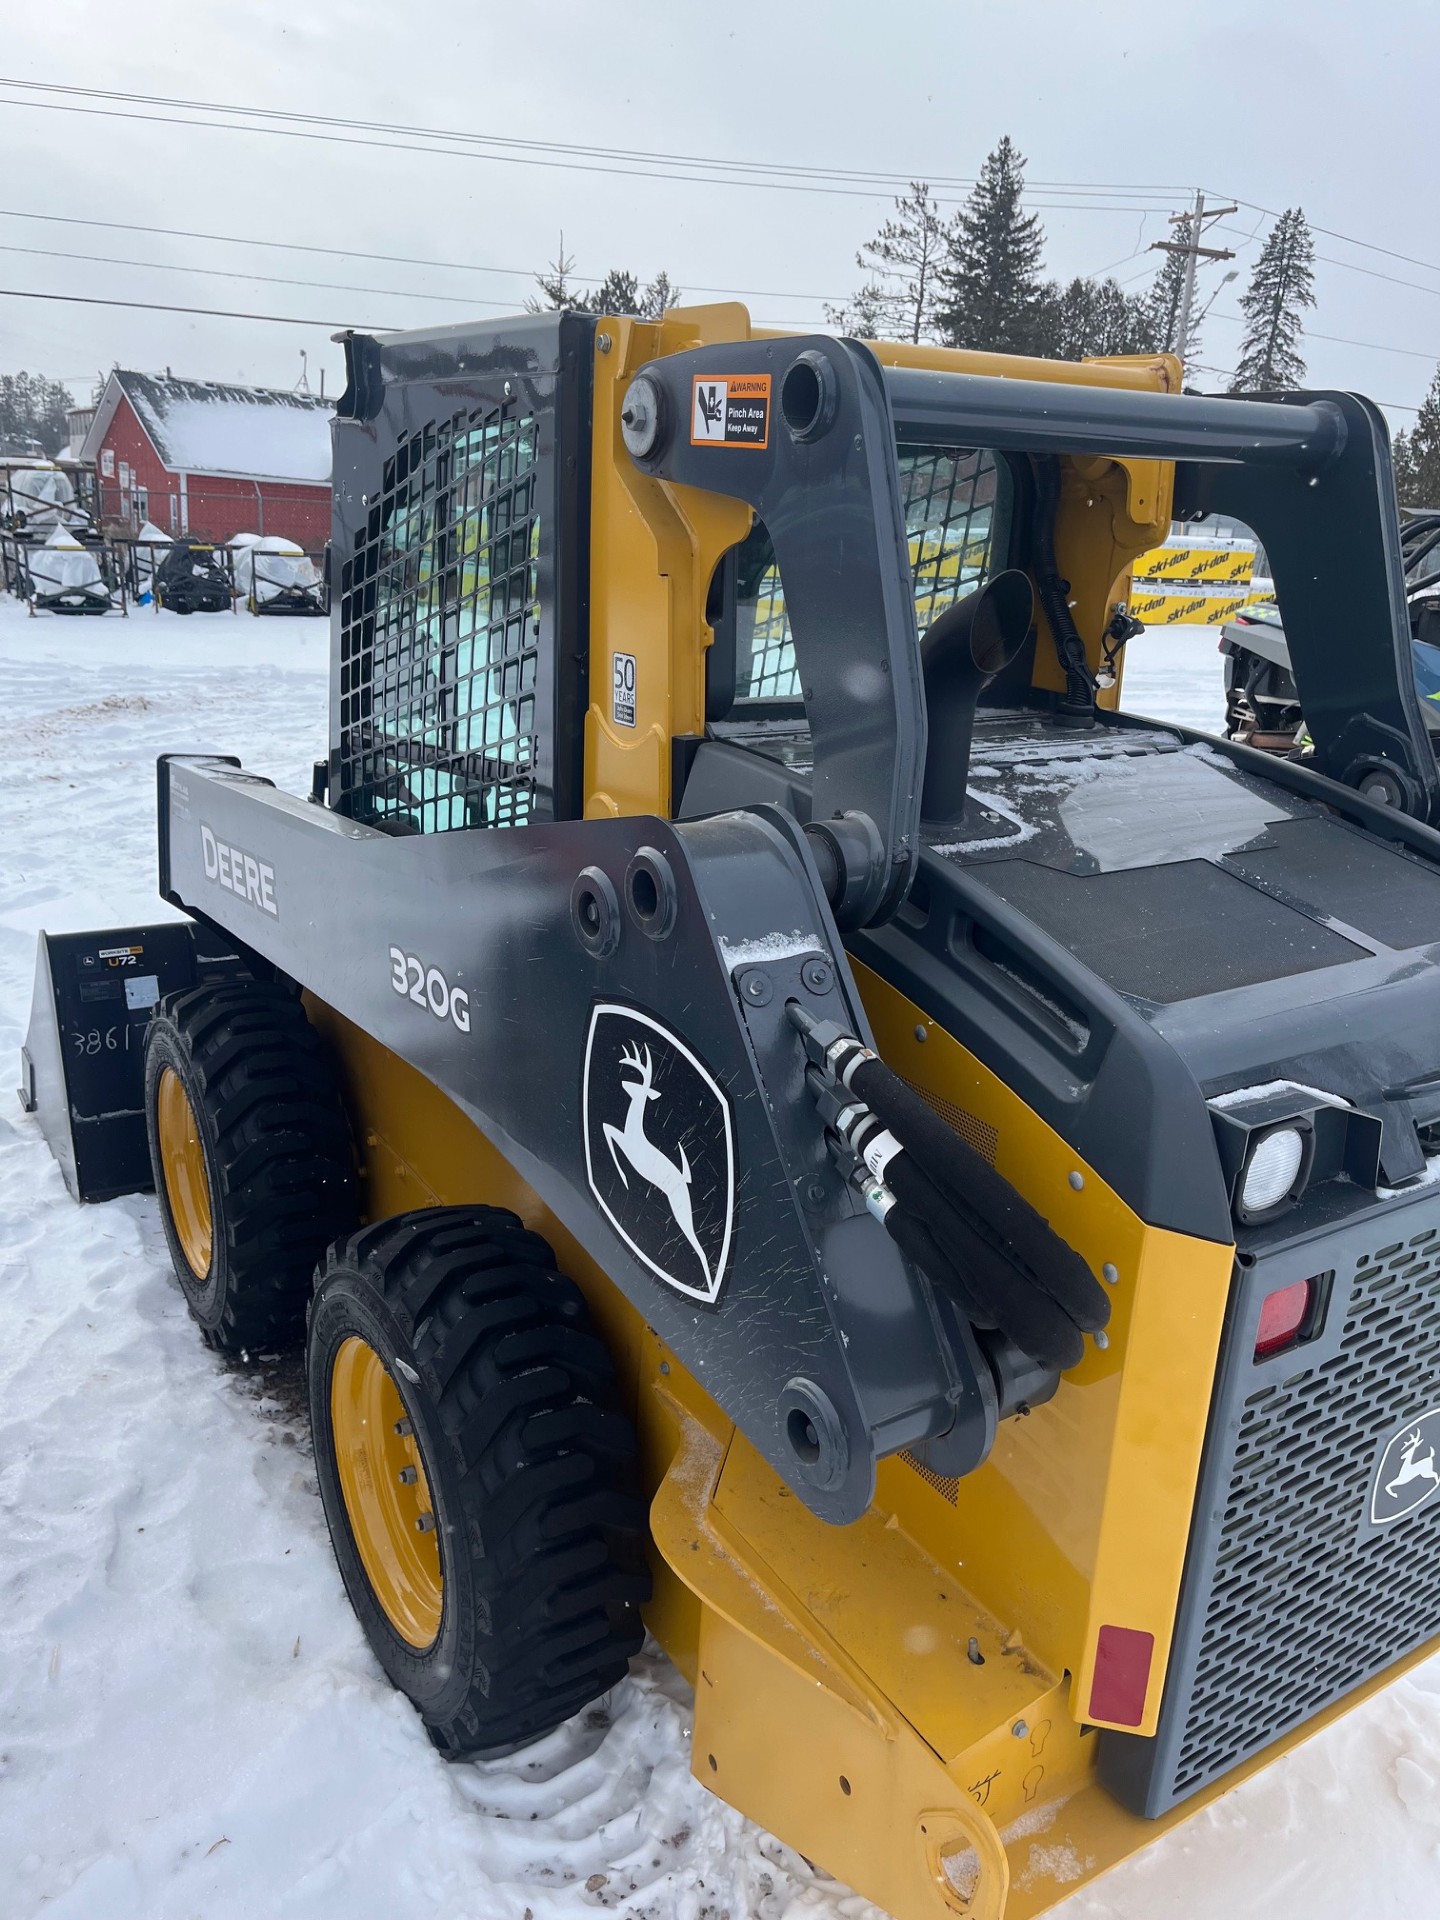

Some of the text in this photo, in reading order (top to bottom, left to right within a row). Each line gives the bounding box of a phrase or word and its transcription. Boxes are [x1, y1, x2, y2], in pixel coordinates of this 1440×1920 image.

[736, 382, 767, 392] WARNING
[728, 407, 764, 419] Pinch Area
[727, 423, 758, 435] Keep Away
[1147, 550, 1190, 576] ski-doo
[1190, 552, 1230, 577] ski-doo
[1130, 596, 1166, 616] ki-doo
[1166, 598, 1206, 624] ski-doo
[1206, 599, 1245, 624] ski-doo
[615, 656, 635, 692] 50
[615, 690, 634, 705] YEARS
[200, 824, 278, 916] DEERE
[108, 955, 137, 967] U72
[389, 946, 470, 1032] 320G
